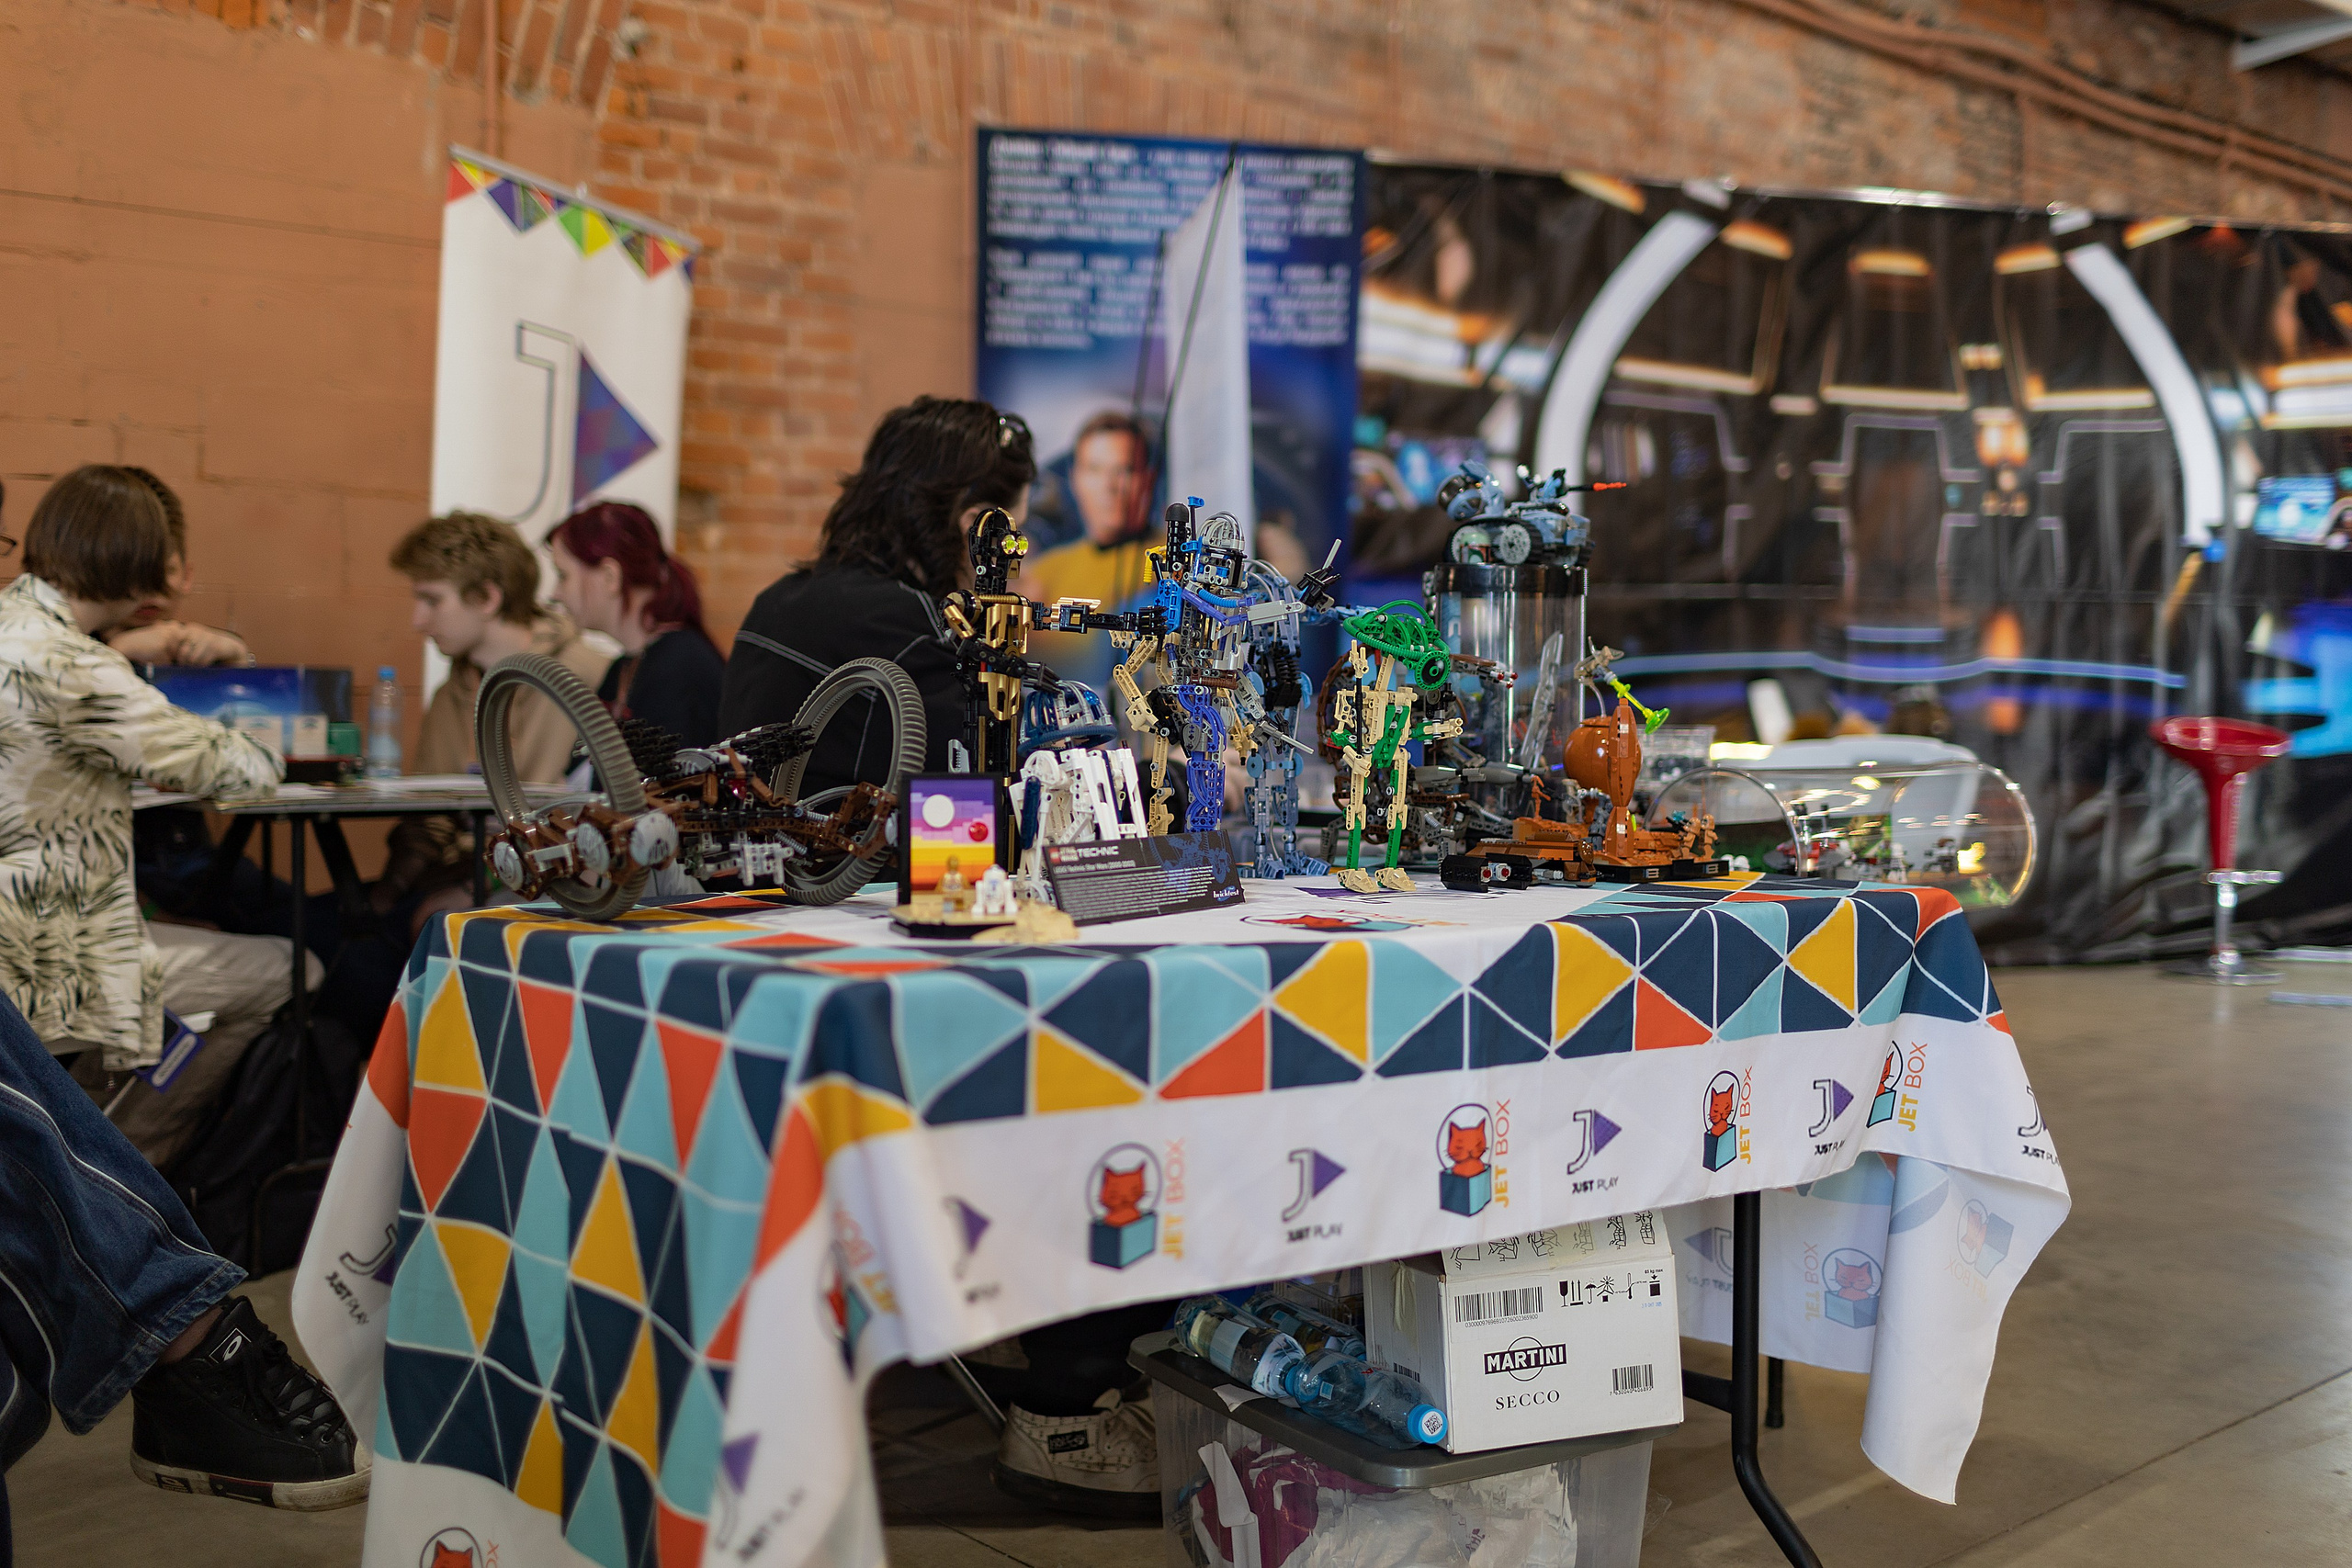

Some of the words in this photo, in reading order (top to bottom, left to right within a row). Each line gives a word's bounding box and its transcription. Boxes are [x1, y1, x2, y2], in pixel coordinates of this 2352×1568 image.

[1077, 846, 1119, 858] TECHNIC
[1904, 1042, 1928, 1089] BOX
[1740, 1066, 1752, 1117] BOX
[1495, 1099, 1510, 1156] BOX
[1898, 1093, 1918, 1132] JET
[1740, 1125, 1751, 1164] JET
[1814, 1143, 1832, 1156] JUST
[2022, 1145, 2045, 1159] JUST
[1164, 1136, 1185, 1203] BOX
[1494, 1166, 1509, 1208] JET
[1572, 1180, 1594, 1194] JUST
[1597, 1176, 1619, 1190] PLAY
[1162, 1213, 1184, 1260] JET
[1487, 1346, 1564, 1372] MARTINI
[1495, 1389, 1560, 1410] SECCO
